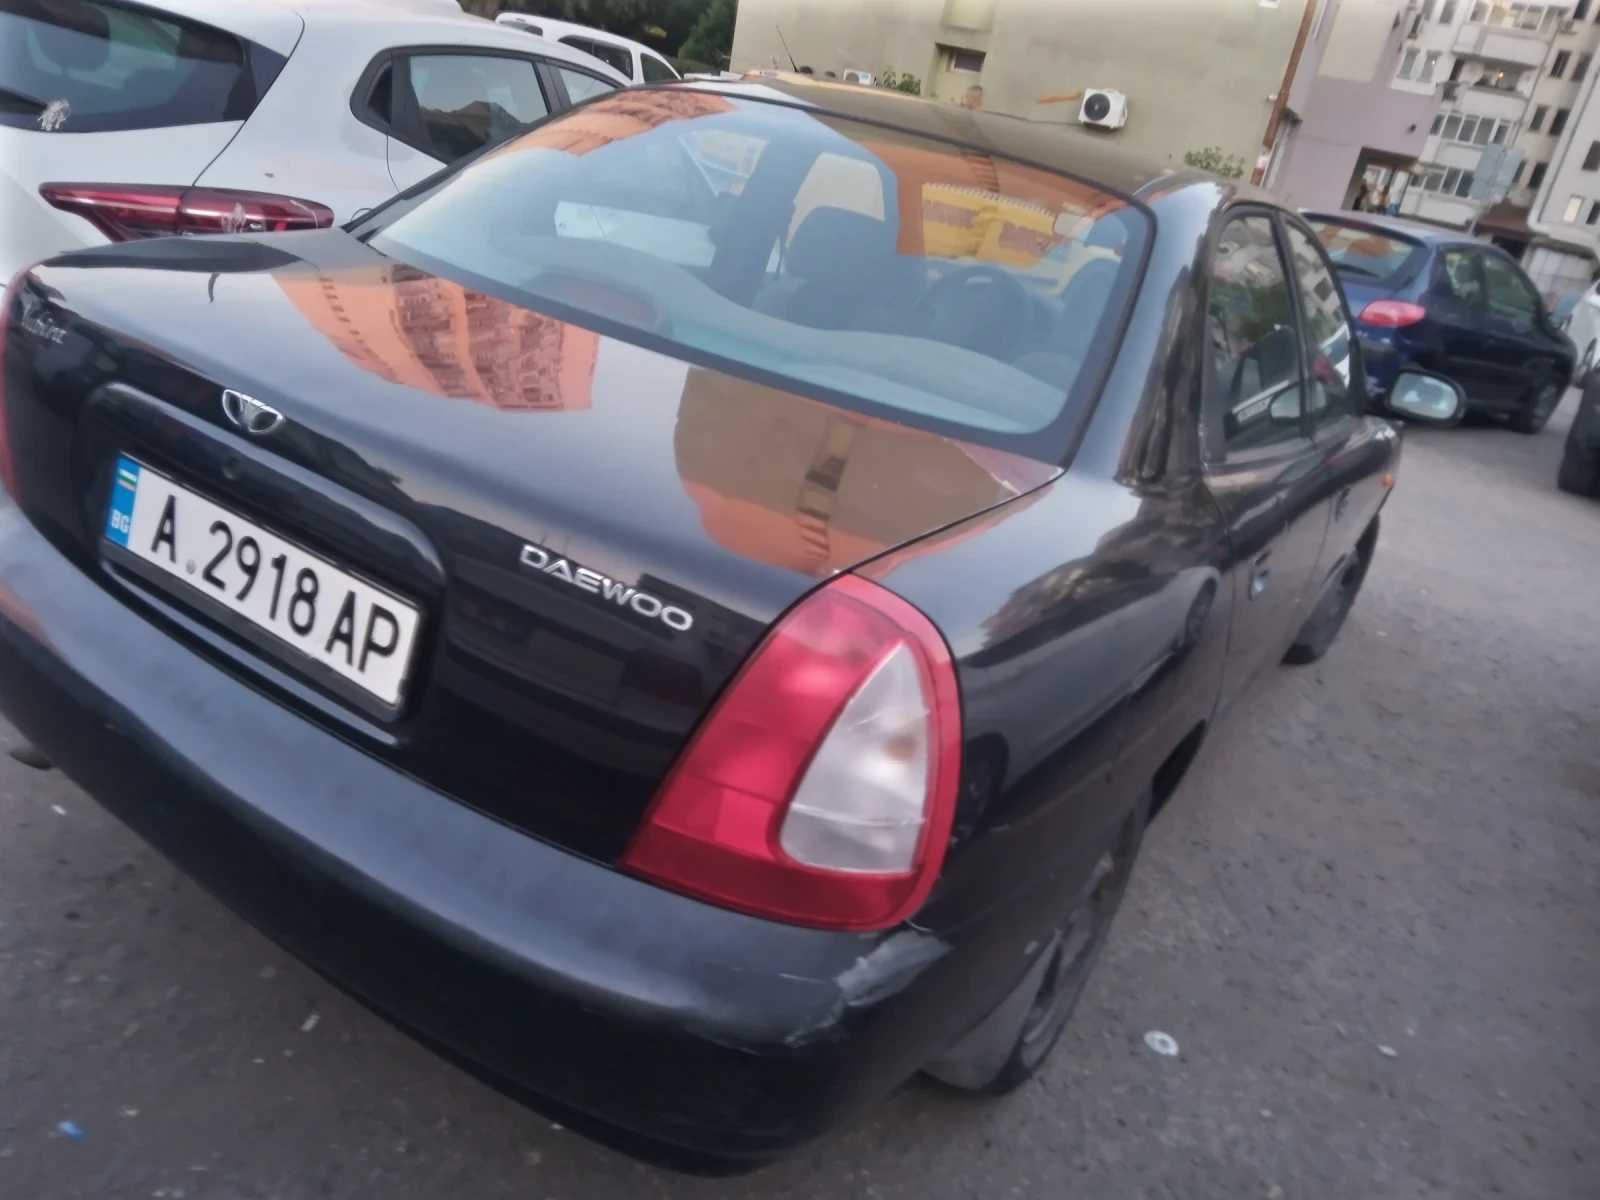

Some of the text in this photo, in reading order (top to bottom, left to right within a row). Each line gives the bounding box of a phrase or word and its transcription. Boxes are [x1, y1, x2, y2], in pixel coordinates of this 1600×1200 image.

[111, 508, 130, 534] BG
[202, 520, 319, 637] 2918
[520, 544, 693, 631] DAEWOO
